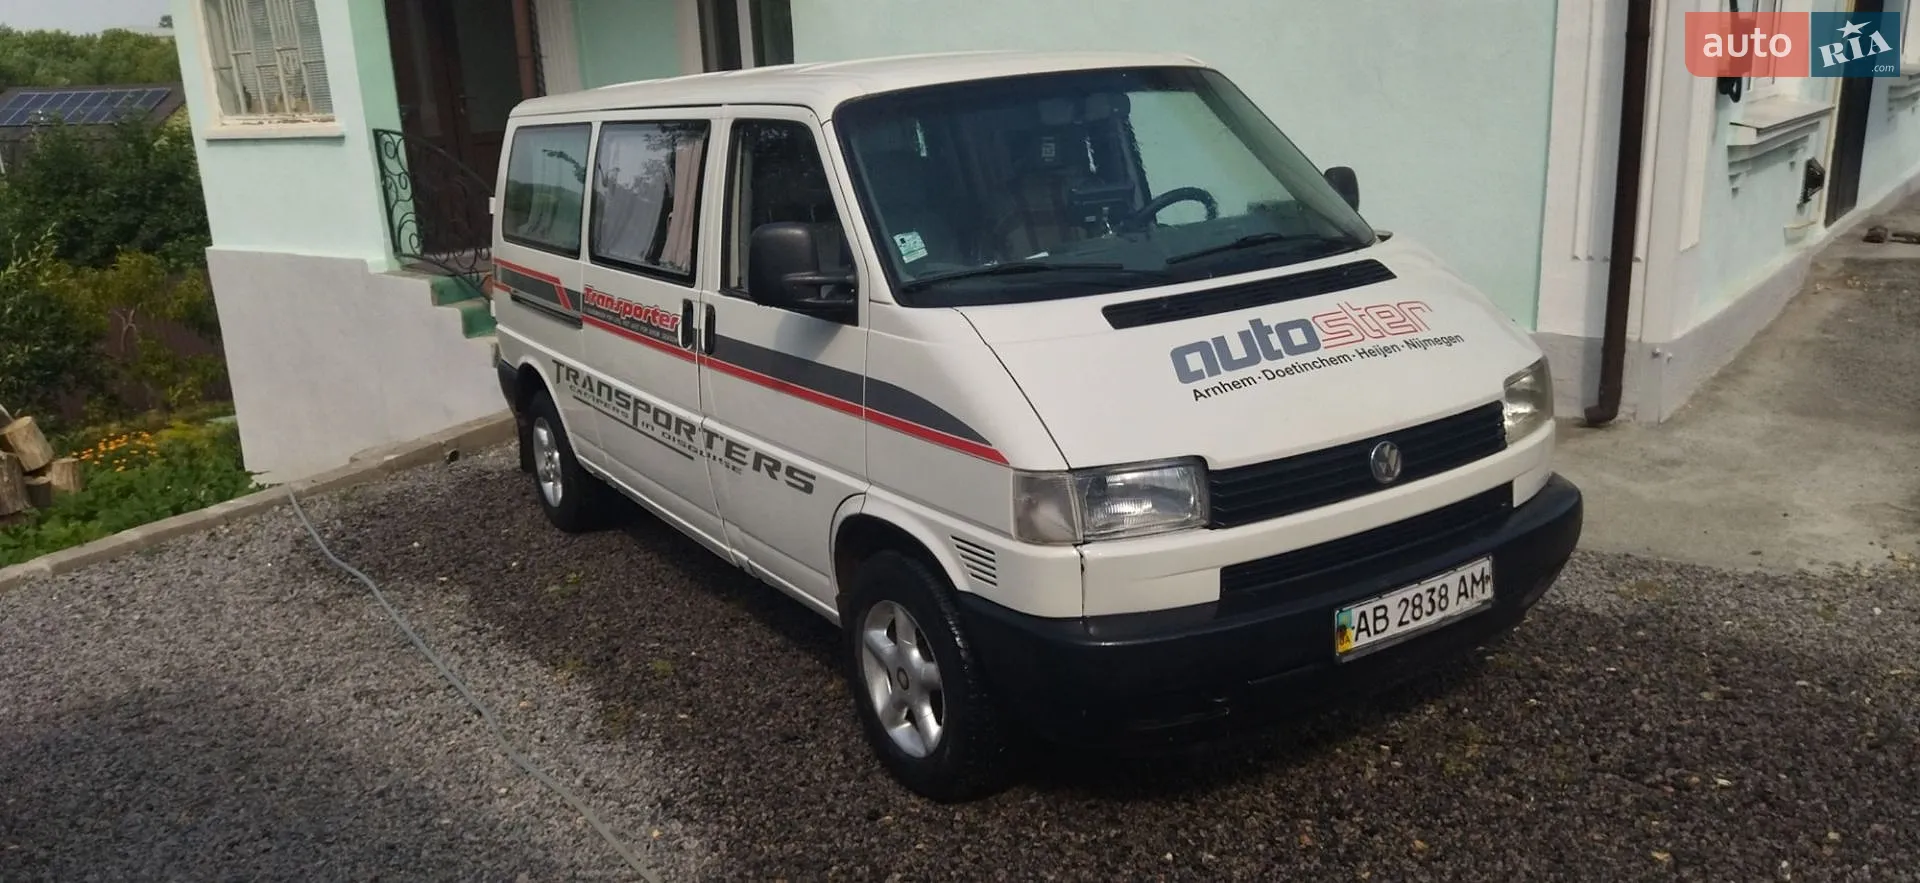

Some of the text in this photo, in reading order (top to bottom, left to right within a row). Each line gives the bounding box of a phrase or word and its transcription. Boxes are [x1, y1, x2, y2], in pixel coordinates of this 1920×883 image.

[583, 284, 680, 333] Transporter
[1170, 300, 1433, 384] autoster
[1192, 333, 1464, 402] Arnhem Doetinchem Heijen Nijmegen
[1354, 567, 1486, 642] AB 2838 AM
